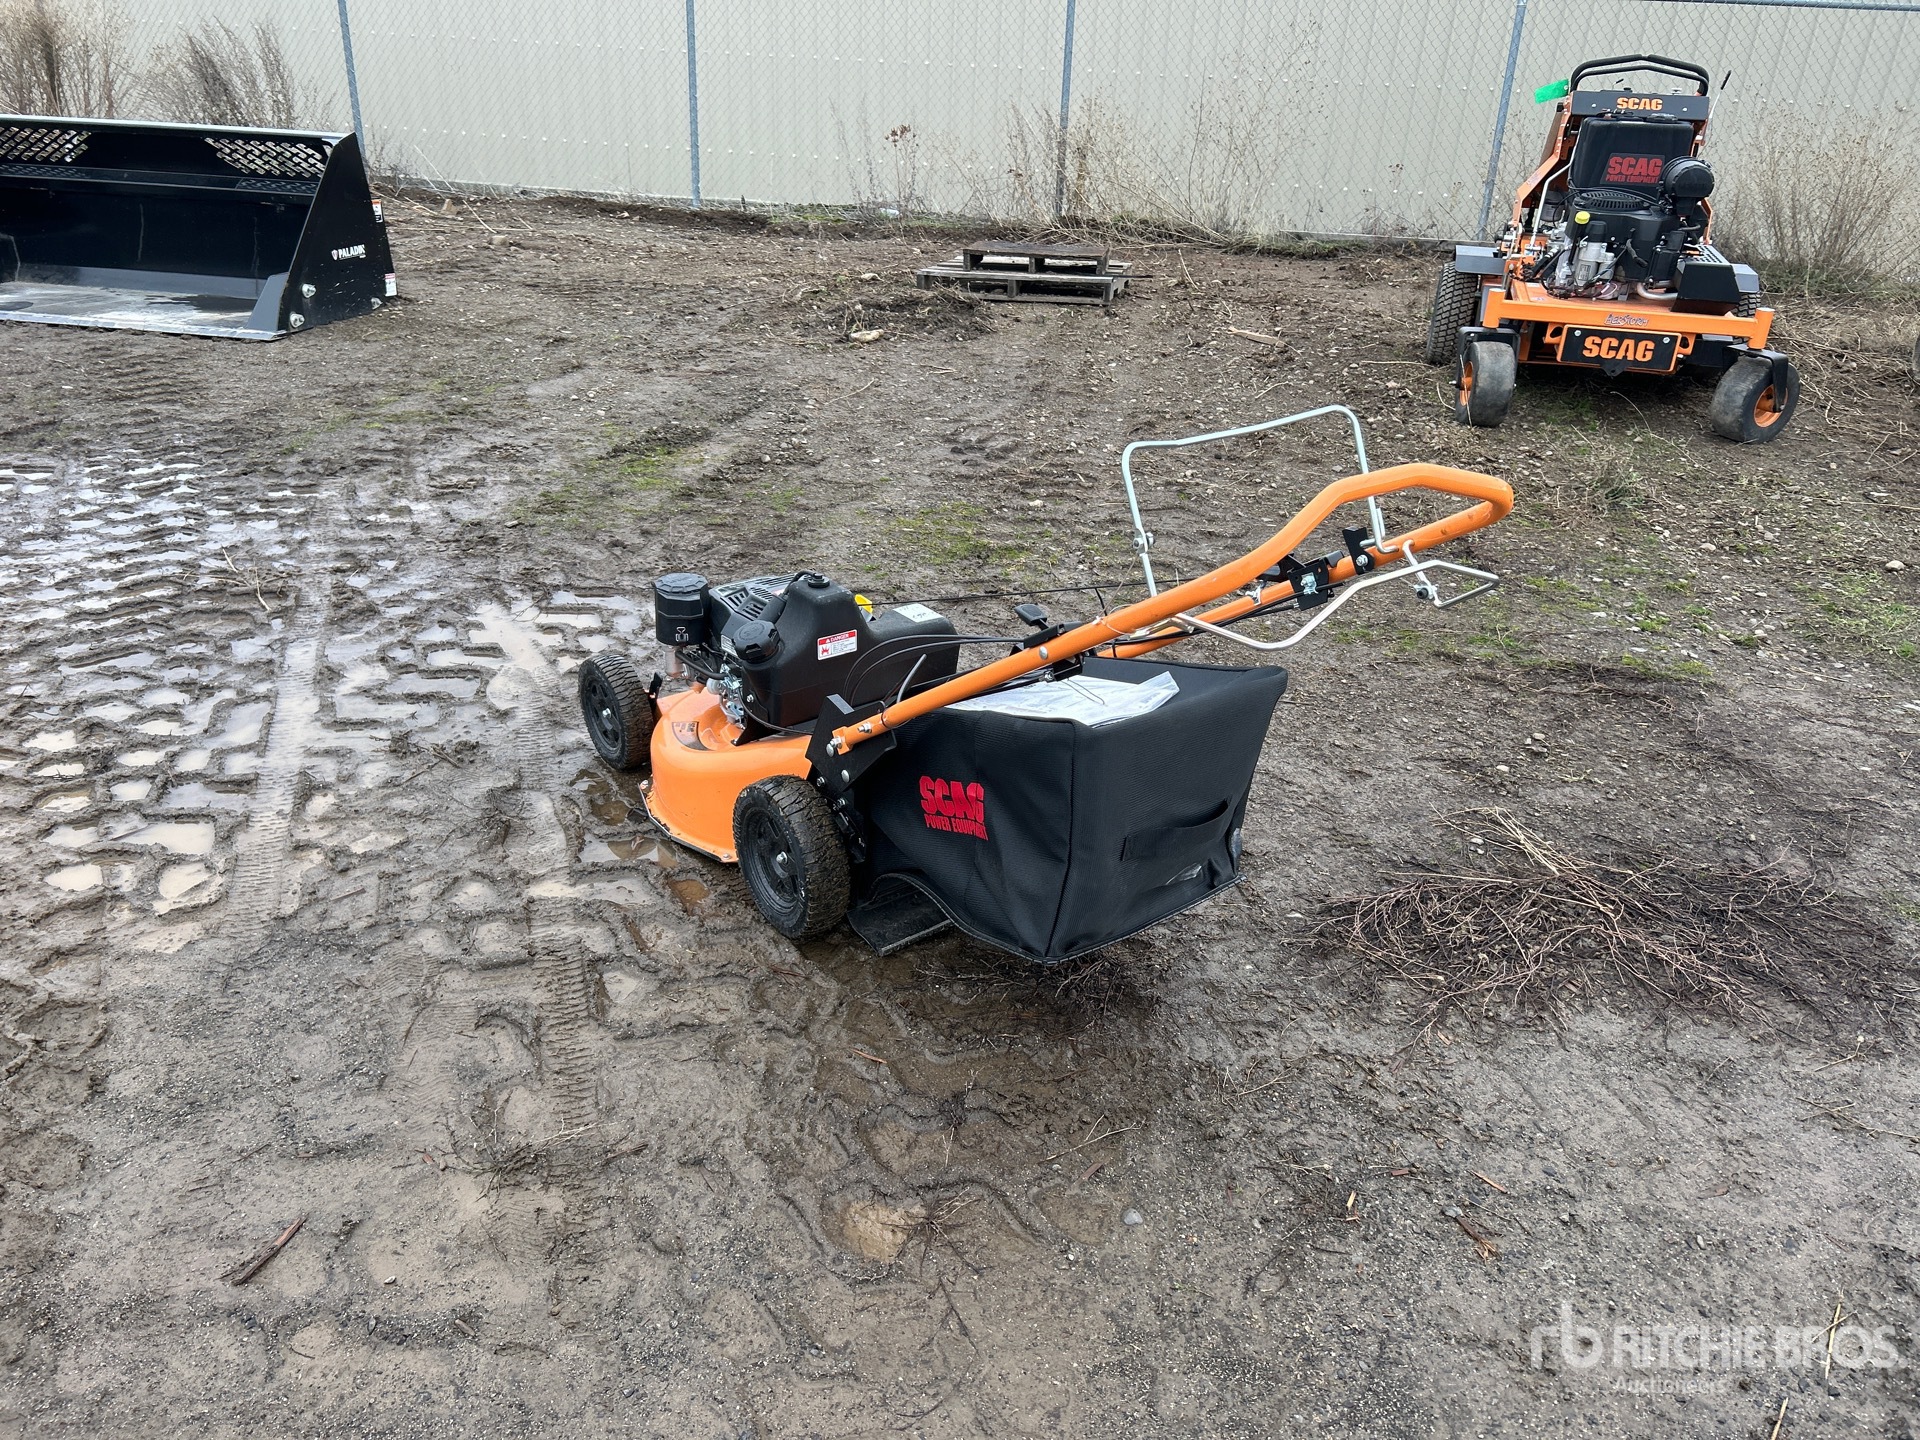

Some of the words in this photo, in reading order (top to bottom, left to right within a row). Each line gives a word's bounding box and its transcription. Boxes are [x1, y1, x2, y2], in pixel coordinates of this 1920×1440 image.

[1616, 97, 1663, 111] SCAG
[1607, 156, 1663, 177] SCAG
[1605, 174, 1626, 182] POWER
[1583, 336, 1655, 361] SCAG
[920, 776, 984, 823] SCAG
[924, 814, 951, 831] POWER
